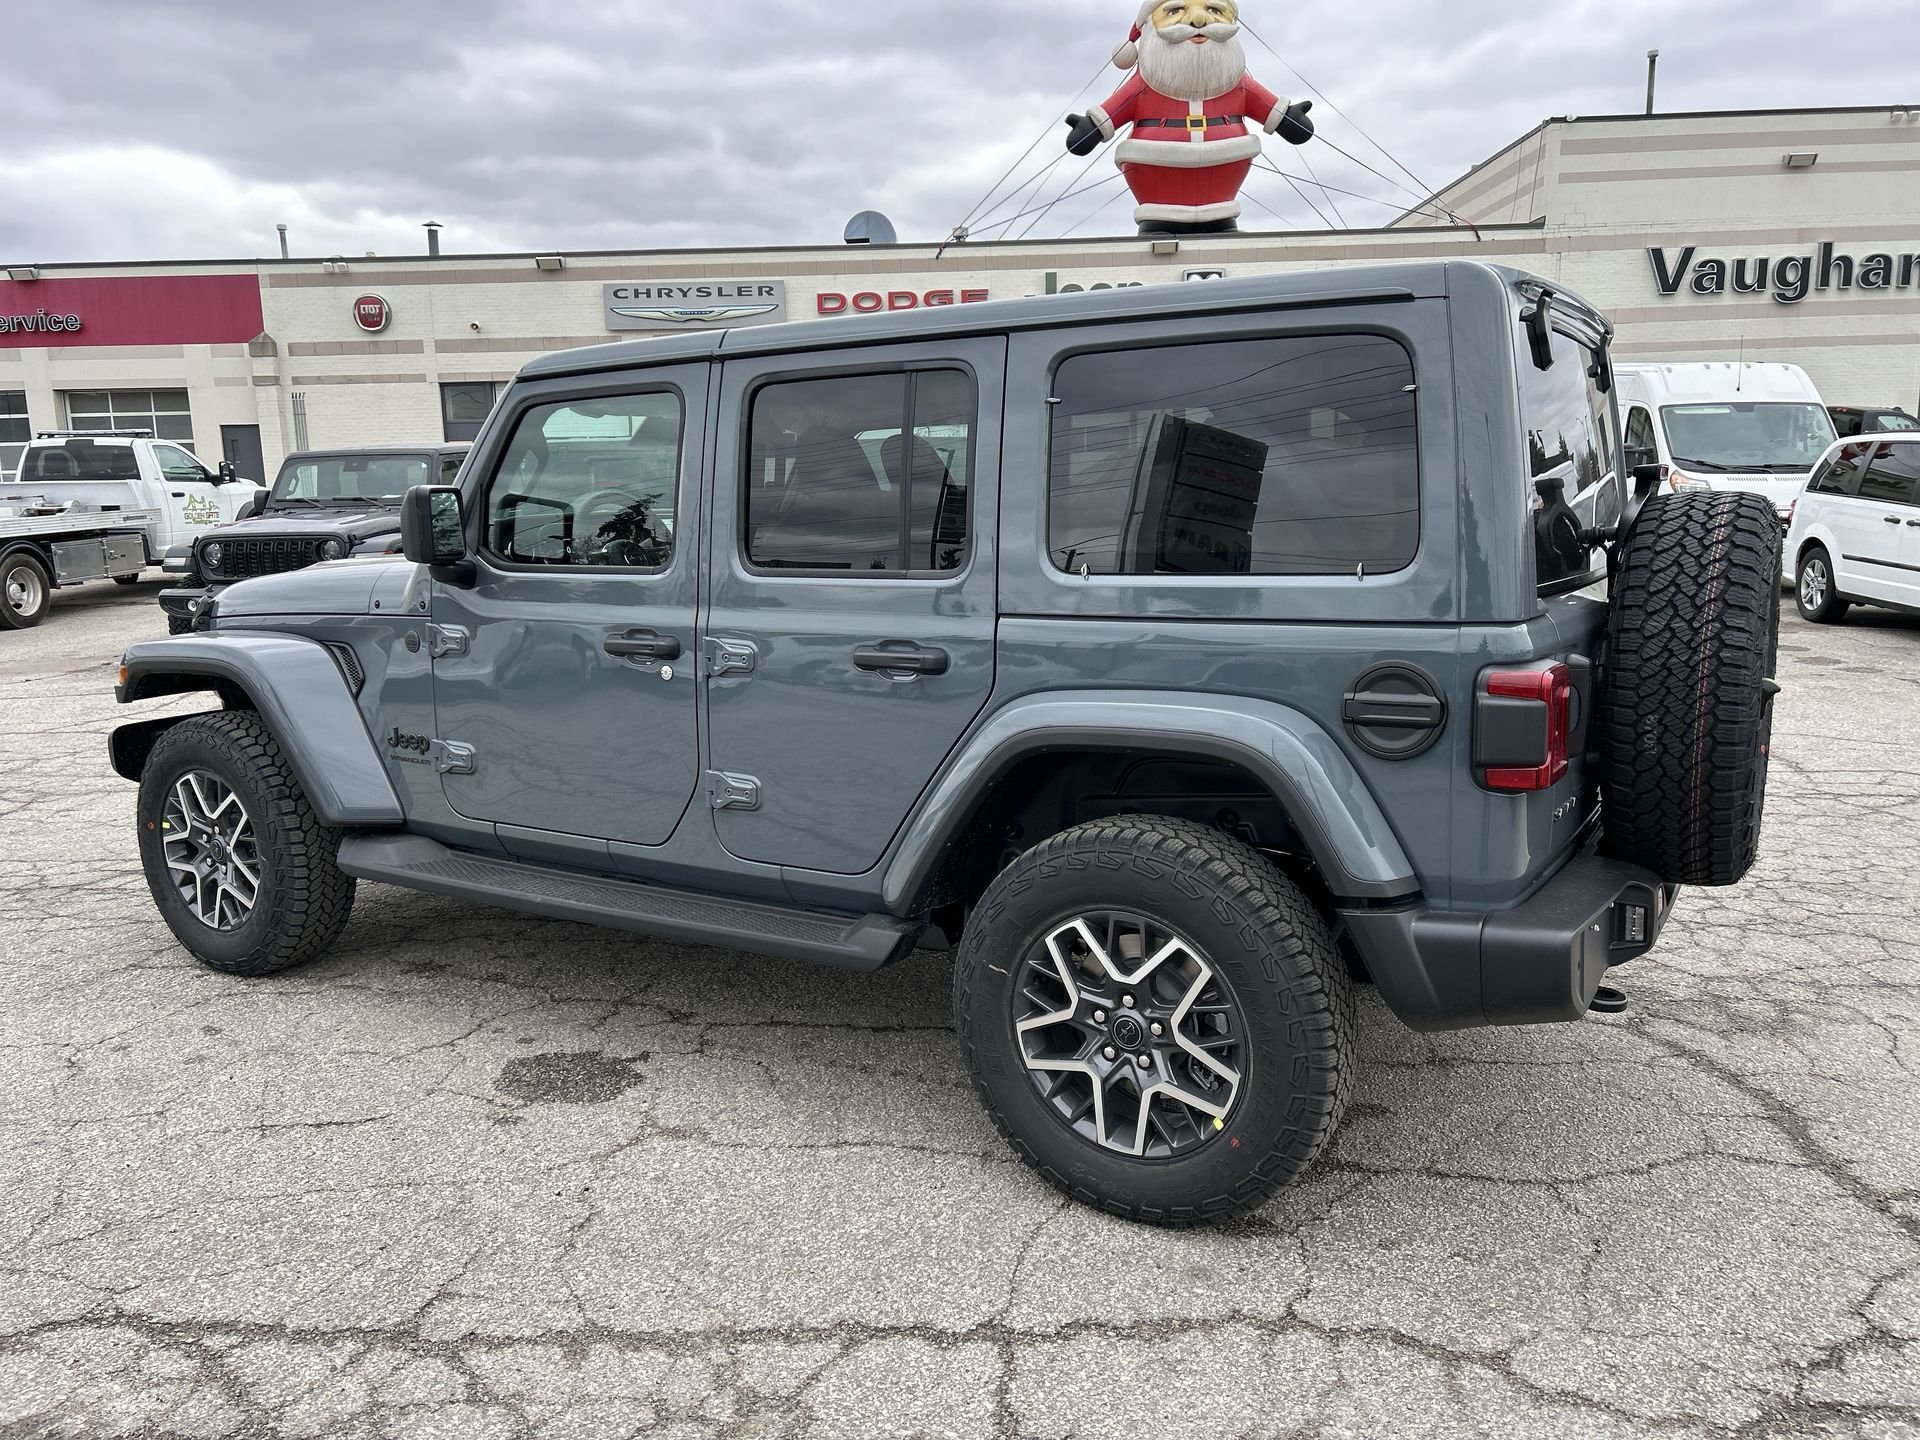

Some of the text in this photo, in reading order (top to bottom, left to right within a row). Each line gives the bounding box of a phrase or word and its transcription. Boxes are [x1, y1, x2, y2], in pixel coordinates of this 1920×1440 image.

[1647, 240, 1920, 304] Vaughan
[612, 285, 775, 300] CHRYSLER
[816, 288, 989, 313] DODGE
[387, 726, 430, 755] Jeep
[390, 754, 431, 766] WRANGLER
